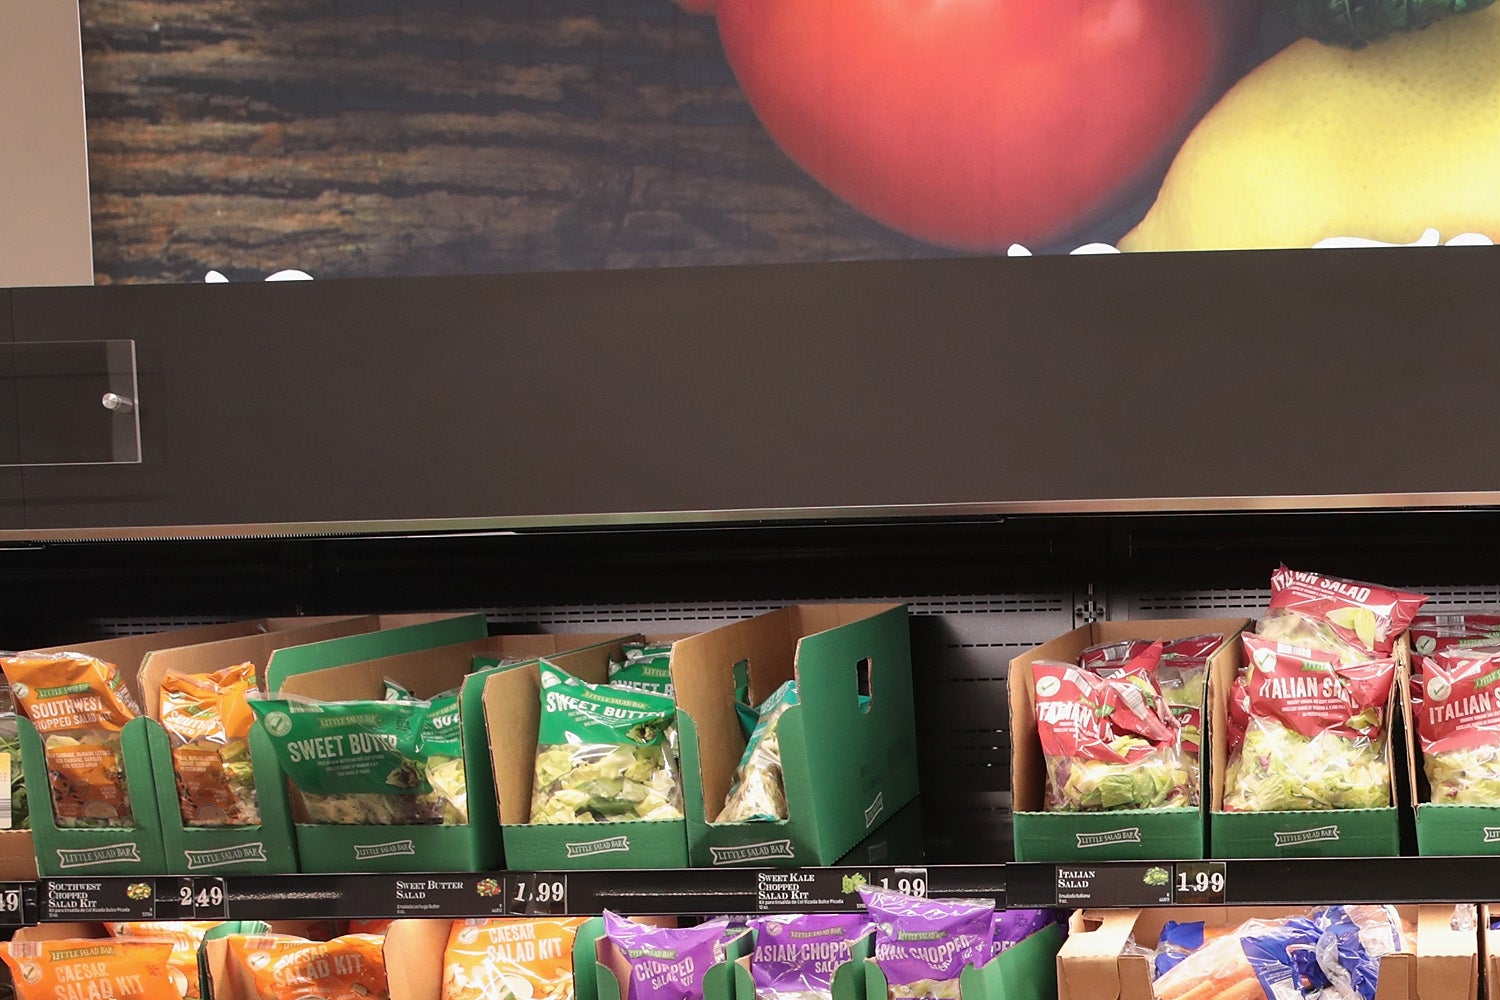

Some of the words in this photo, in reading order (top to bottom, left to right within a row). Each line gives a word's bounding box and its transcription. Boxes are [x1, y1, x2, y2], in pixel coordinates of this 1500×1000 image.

[30, 695, 104, 719] SOUTHWEST
[1429, 691, 1491, 724] ITALIAN
[287, 735, 344, 762] SWEET
[348, 733, 398, 754] BUTTER
[758, 873, 788, 882] SWEET
[789, 873, 815, 882] KALE
[1058, 870, 1096, 879] ITALIAN
[1058, 879, 1089, 888] SALAD
[1176, 871, 1224, 892] 1.99
[48, 881, 102, 891] SOUTHWEST
[48, 890, 88, 900] CHOPPED
[396, 881, 425, 890] SWEET
[426, 881, 464, 890] BUTTER
[396, 891, 426, 899] SALAD
[758, 882, 799, 891] CHOPPED
[758, 891, 788, 900] SALAD
[790, 891, 810, 900] KIT
[880, 877, 926, 898] 199
[48, 899, 78, 908] SALAD
[79, 899, 98, 908] KIT
[179, 886, 224, 908] 2.49
[488, 922, 536, 944] CAESAR
[486, 941, 536, 964] SALAD
[538, 937, 562, 958] KIT
[754, 943, 797, 963] ASIAN
[55, 962, 109, 982] CAESAR
[114, 974, 145, 996] KIT
